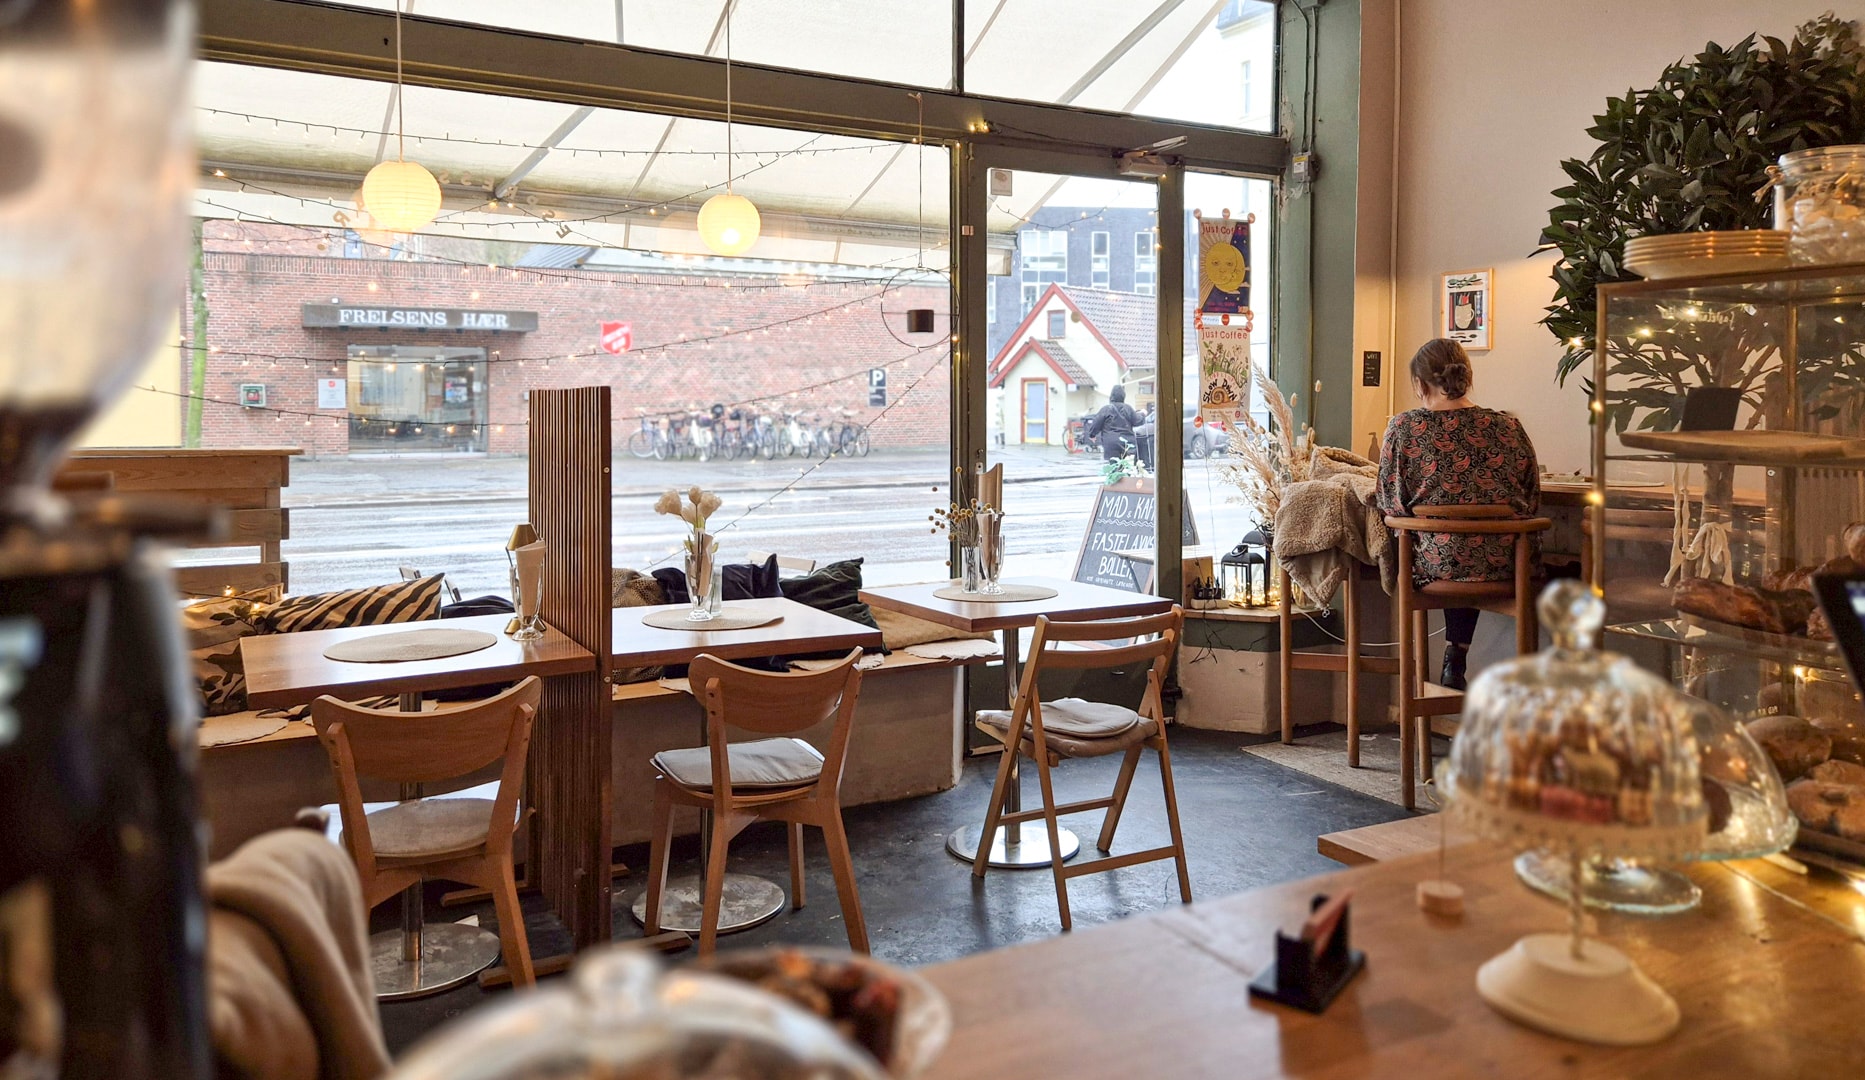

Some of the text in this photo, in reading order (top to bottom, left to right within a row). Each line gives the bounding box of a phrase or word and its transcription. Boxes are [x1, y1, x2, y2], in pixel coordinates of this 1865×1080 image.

[339, 309, 508, 328] FRELSENS HÆR
[1220, 330, 1248, 340] Coffee
[872, 370, 884, 386] P
[1203, 379, 1218, 404] SLOW
[1099, 495, 1129, 519] MAD
